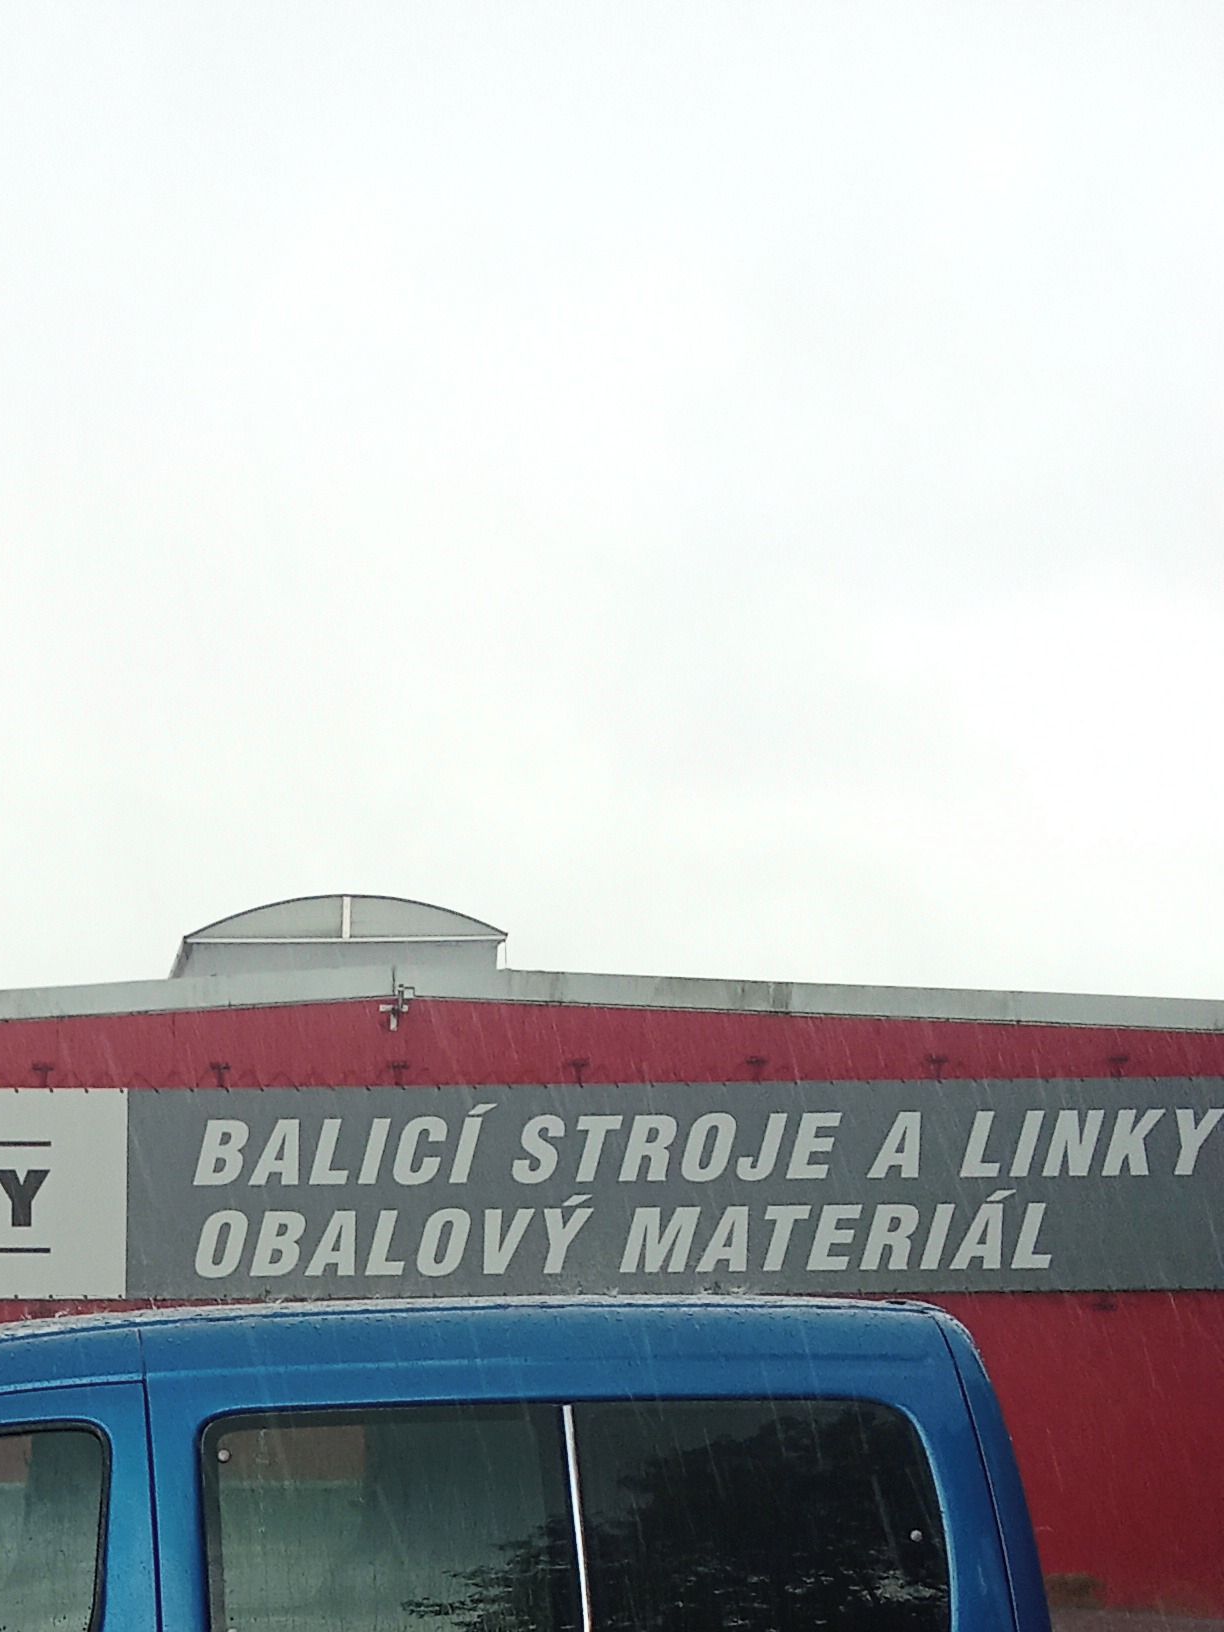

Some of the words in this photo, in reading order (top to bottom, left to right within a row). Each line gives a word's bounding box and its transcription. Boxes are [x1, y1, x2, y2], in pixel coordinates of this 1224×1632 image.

[192, 1103, 498, 1187] BALICÍ
[511, 1111, 843, 1184] STROJE
[866, 1110, 923, 1179] A
[959, 1107, 1224, 1179] LINKY
[194, 1194, 594, 1279] OBALOVÝ
[618, 1189, 1053, 1274] MATERIÁL
